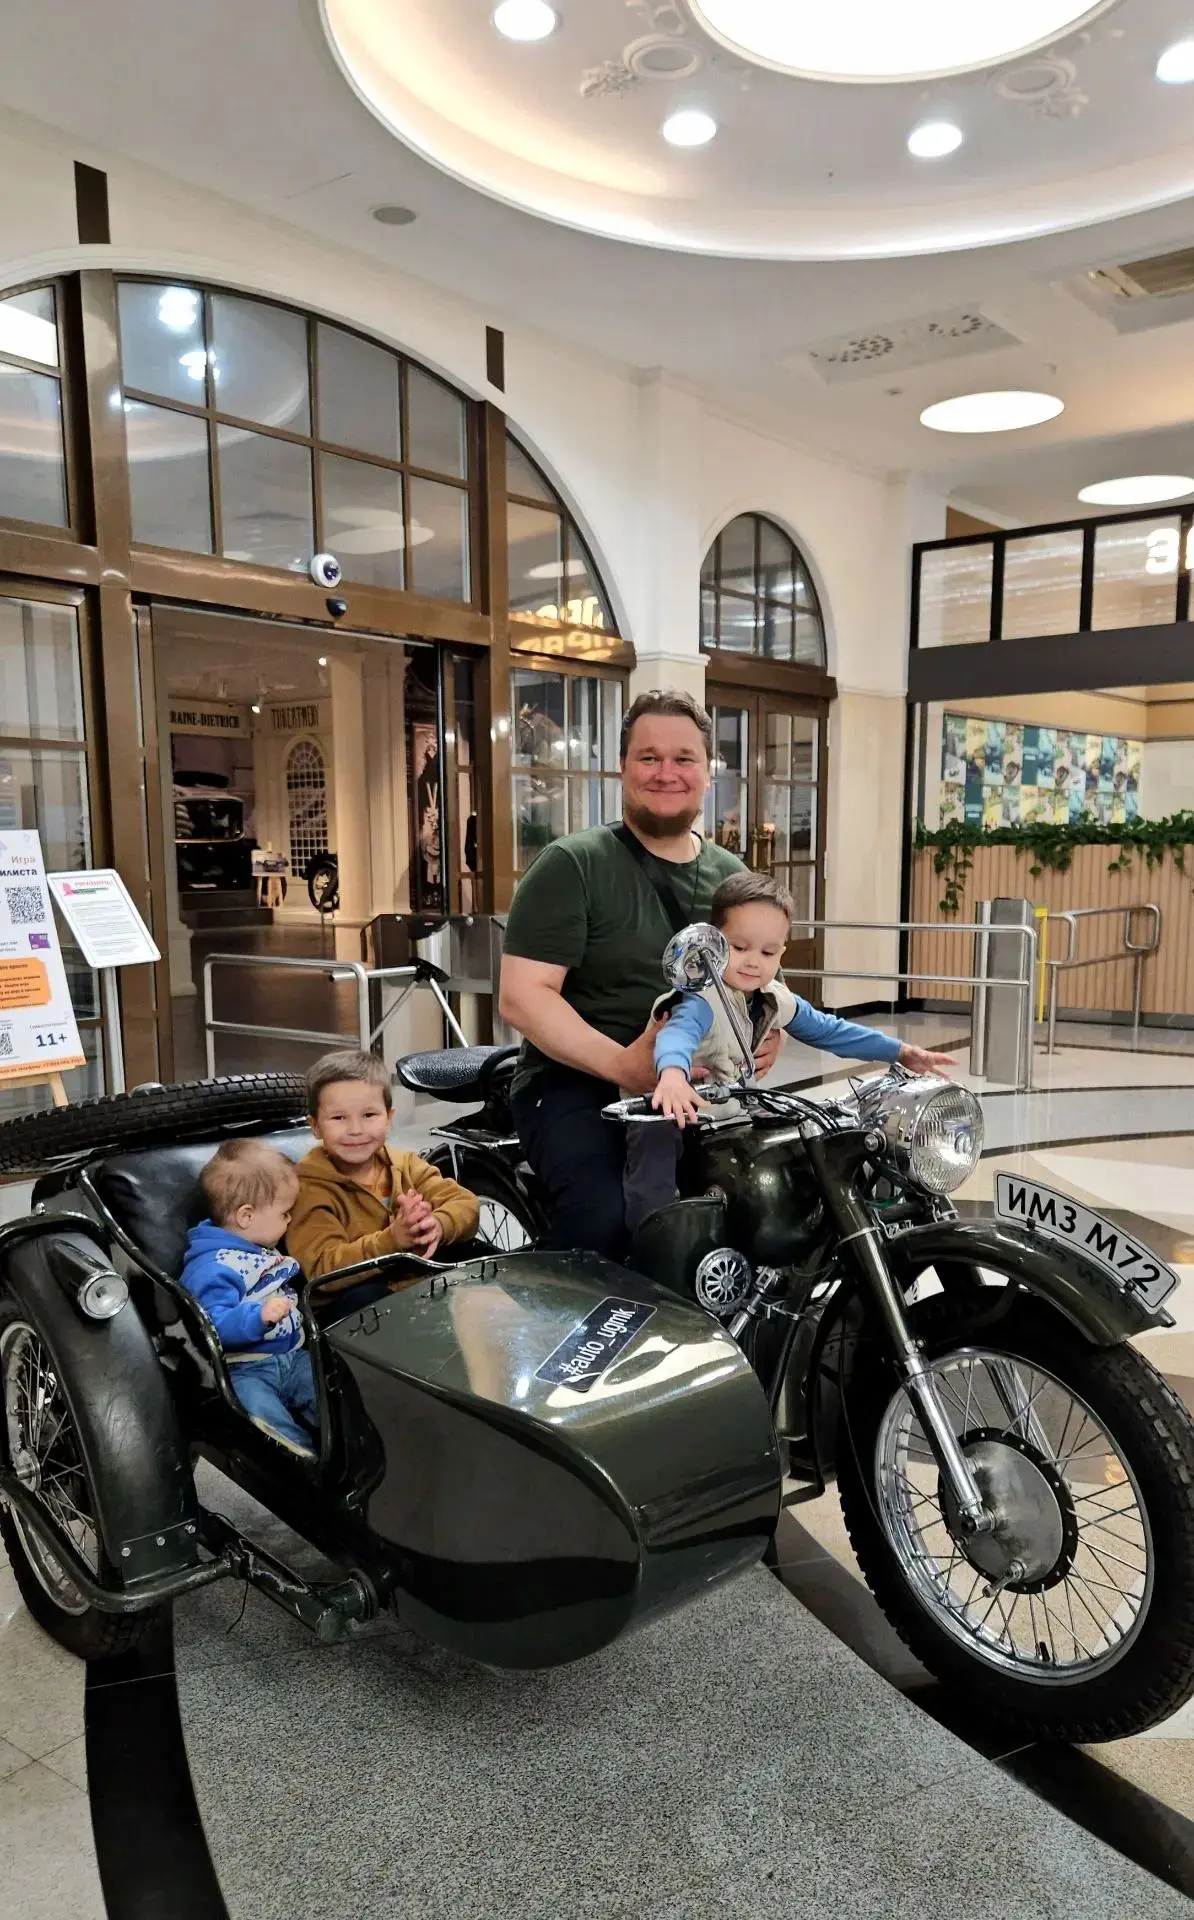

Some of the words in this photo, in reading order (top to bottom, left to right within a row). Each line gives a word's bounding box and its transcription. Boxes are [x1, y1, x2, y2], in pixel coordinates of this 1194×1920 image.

[11, 855, 36, 865] Игра
[36, 1032, 68, 1048] 11+
[1085, 1222, 1160, 1293] М72
